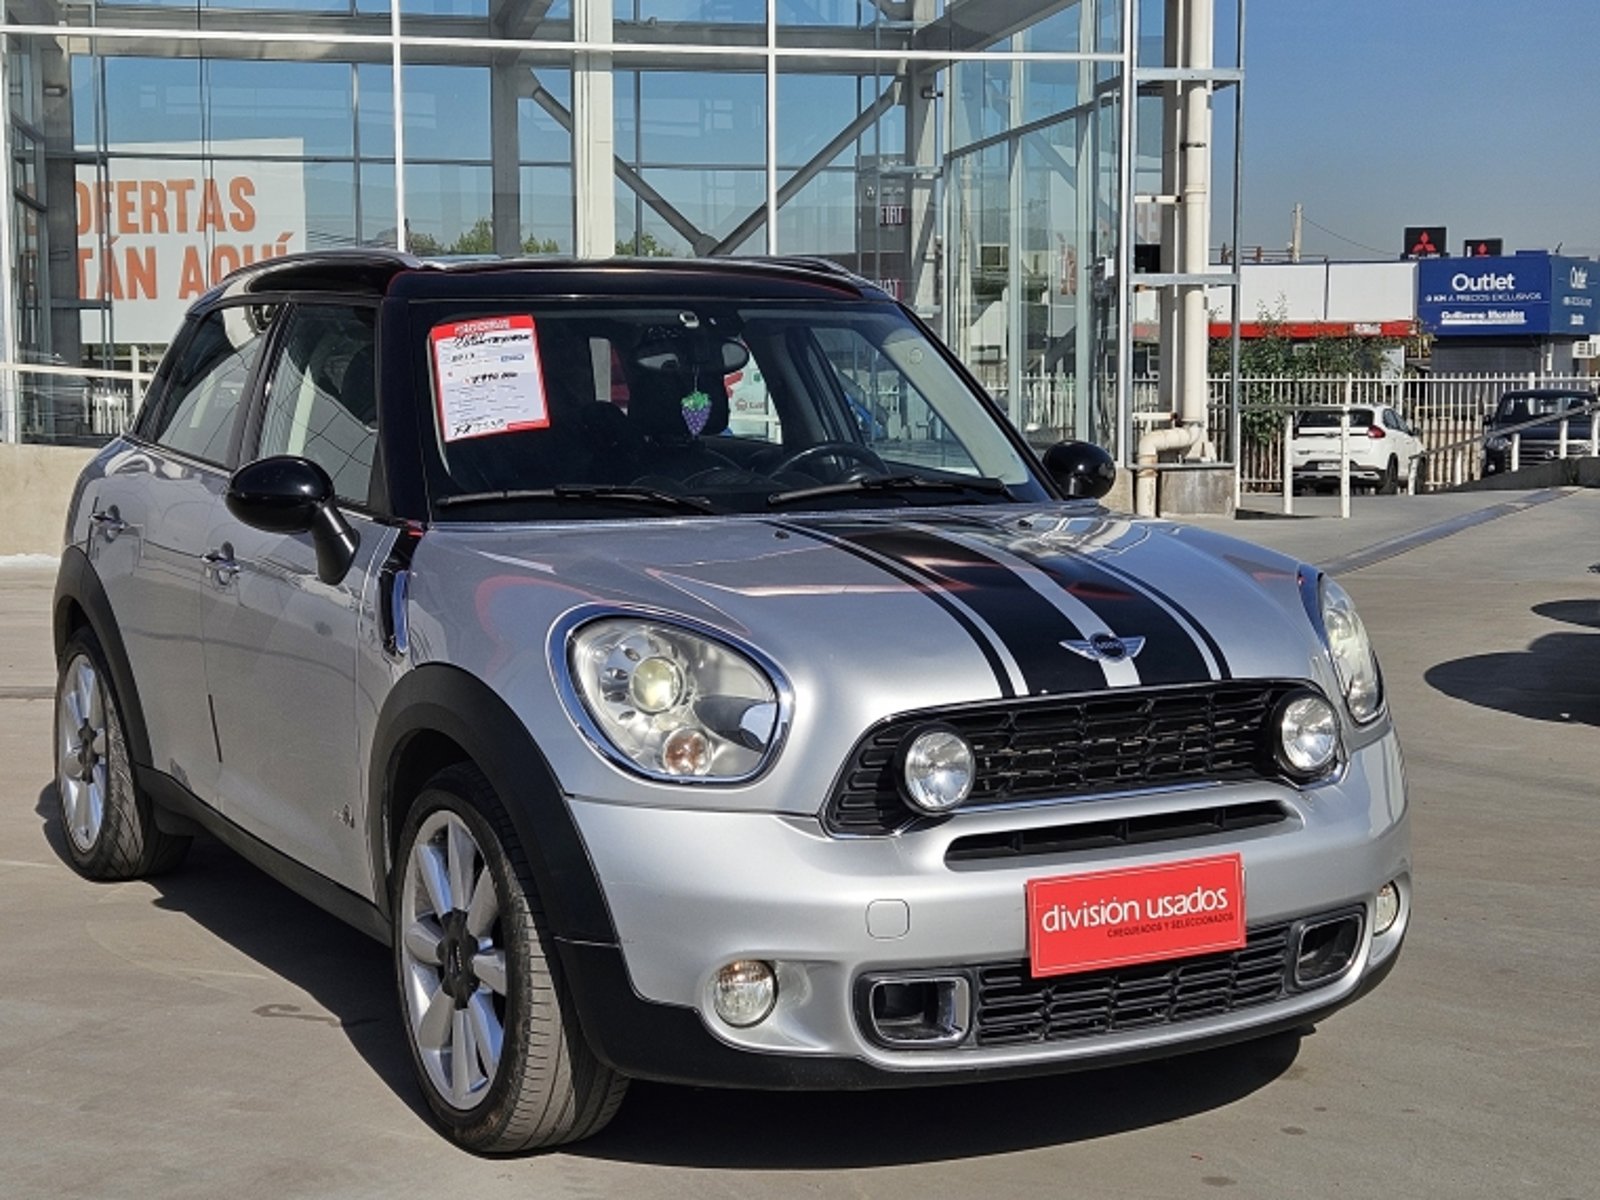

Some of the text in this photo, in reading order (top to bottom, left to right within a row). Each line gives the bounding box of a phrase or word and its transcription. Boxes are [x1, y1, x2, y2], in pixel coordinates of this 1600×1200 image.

[1452, 272, 1516, 291] Outlet
[1041, 885, 1228, 933] división usados
[1107, 921, 1163, 938] CHEQUEADOS
[1171, 912, 1235, 929] SELECCIONADOS
